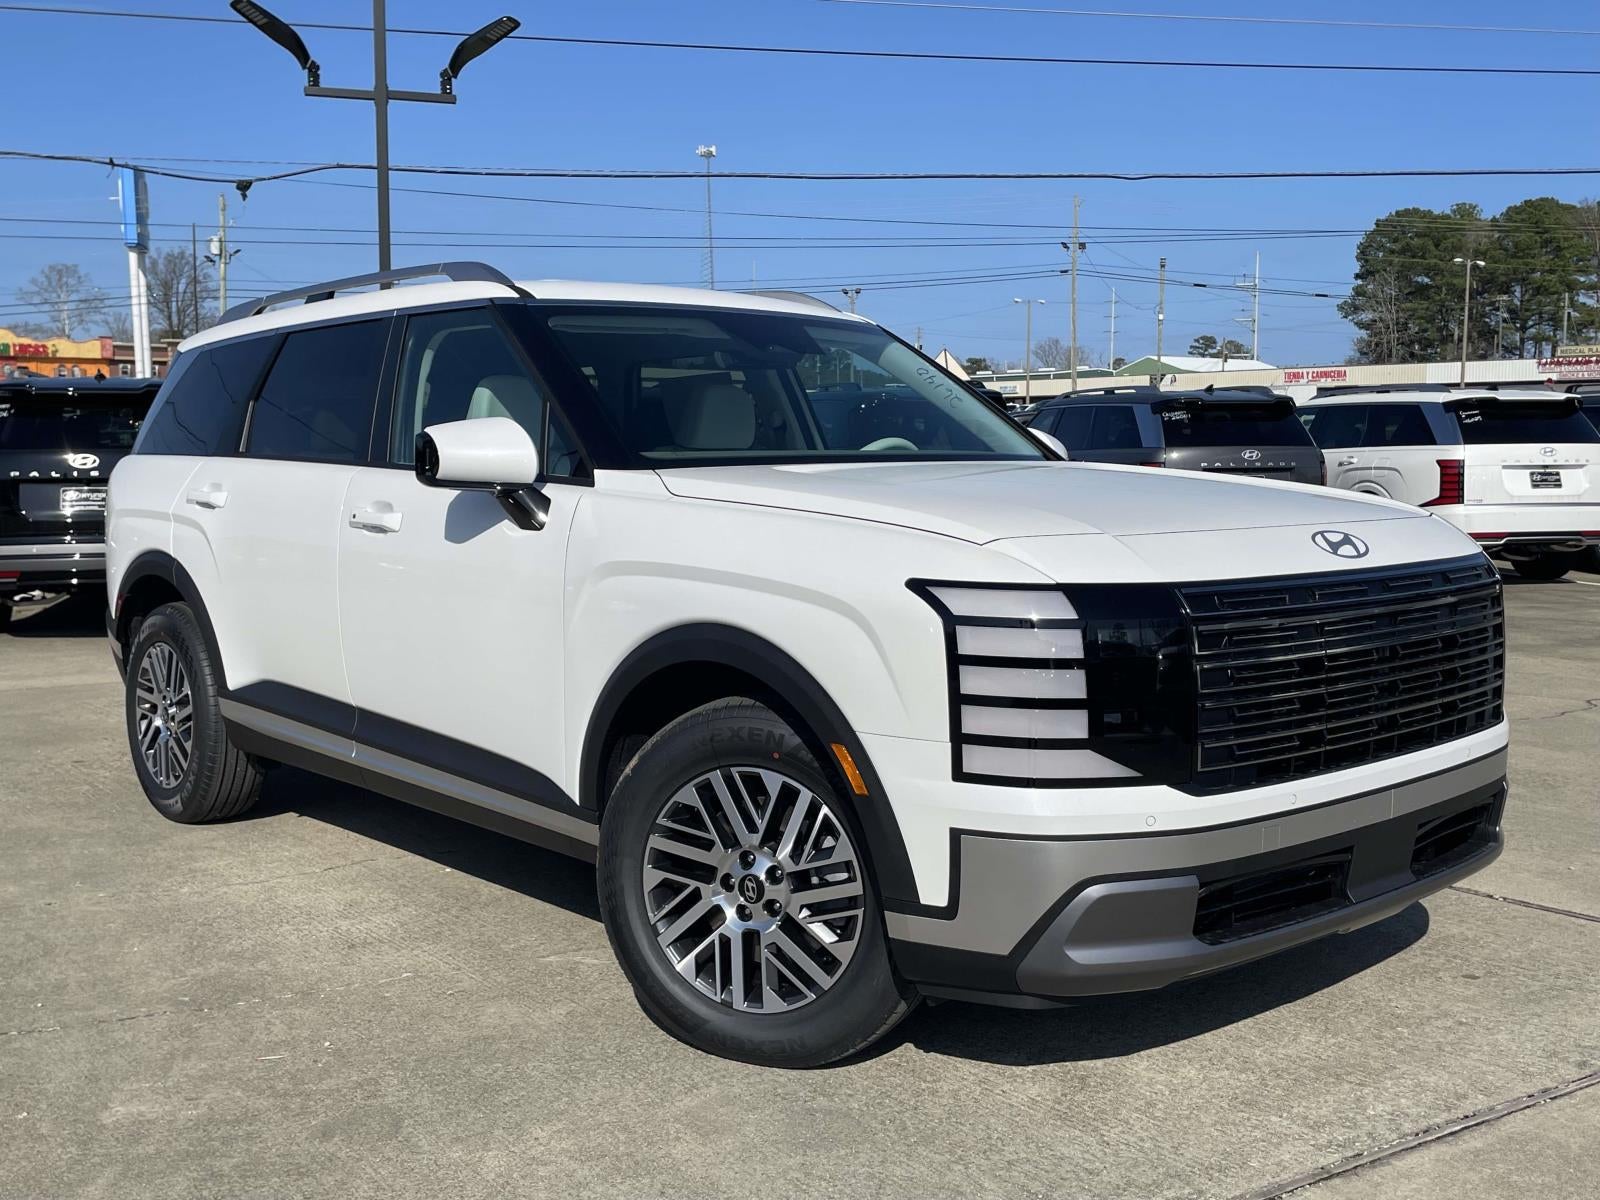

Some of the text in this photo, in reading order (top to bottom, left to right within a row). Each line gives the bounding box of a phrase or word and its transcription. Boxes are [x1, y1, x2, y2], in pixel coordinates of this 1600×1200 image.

[1284, 370, 1347, 380] TIENDA Y CARNICERIA
[690, 727, 785, 750] NEXEN
